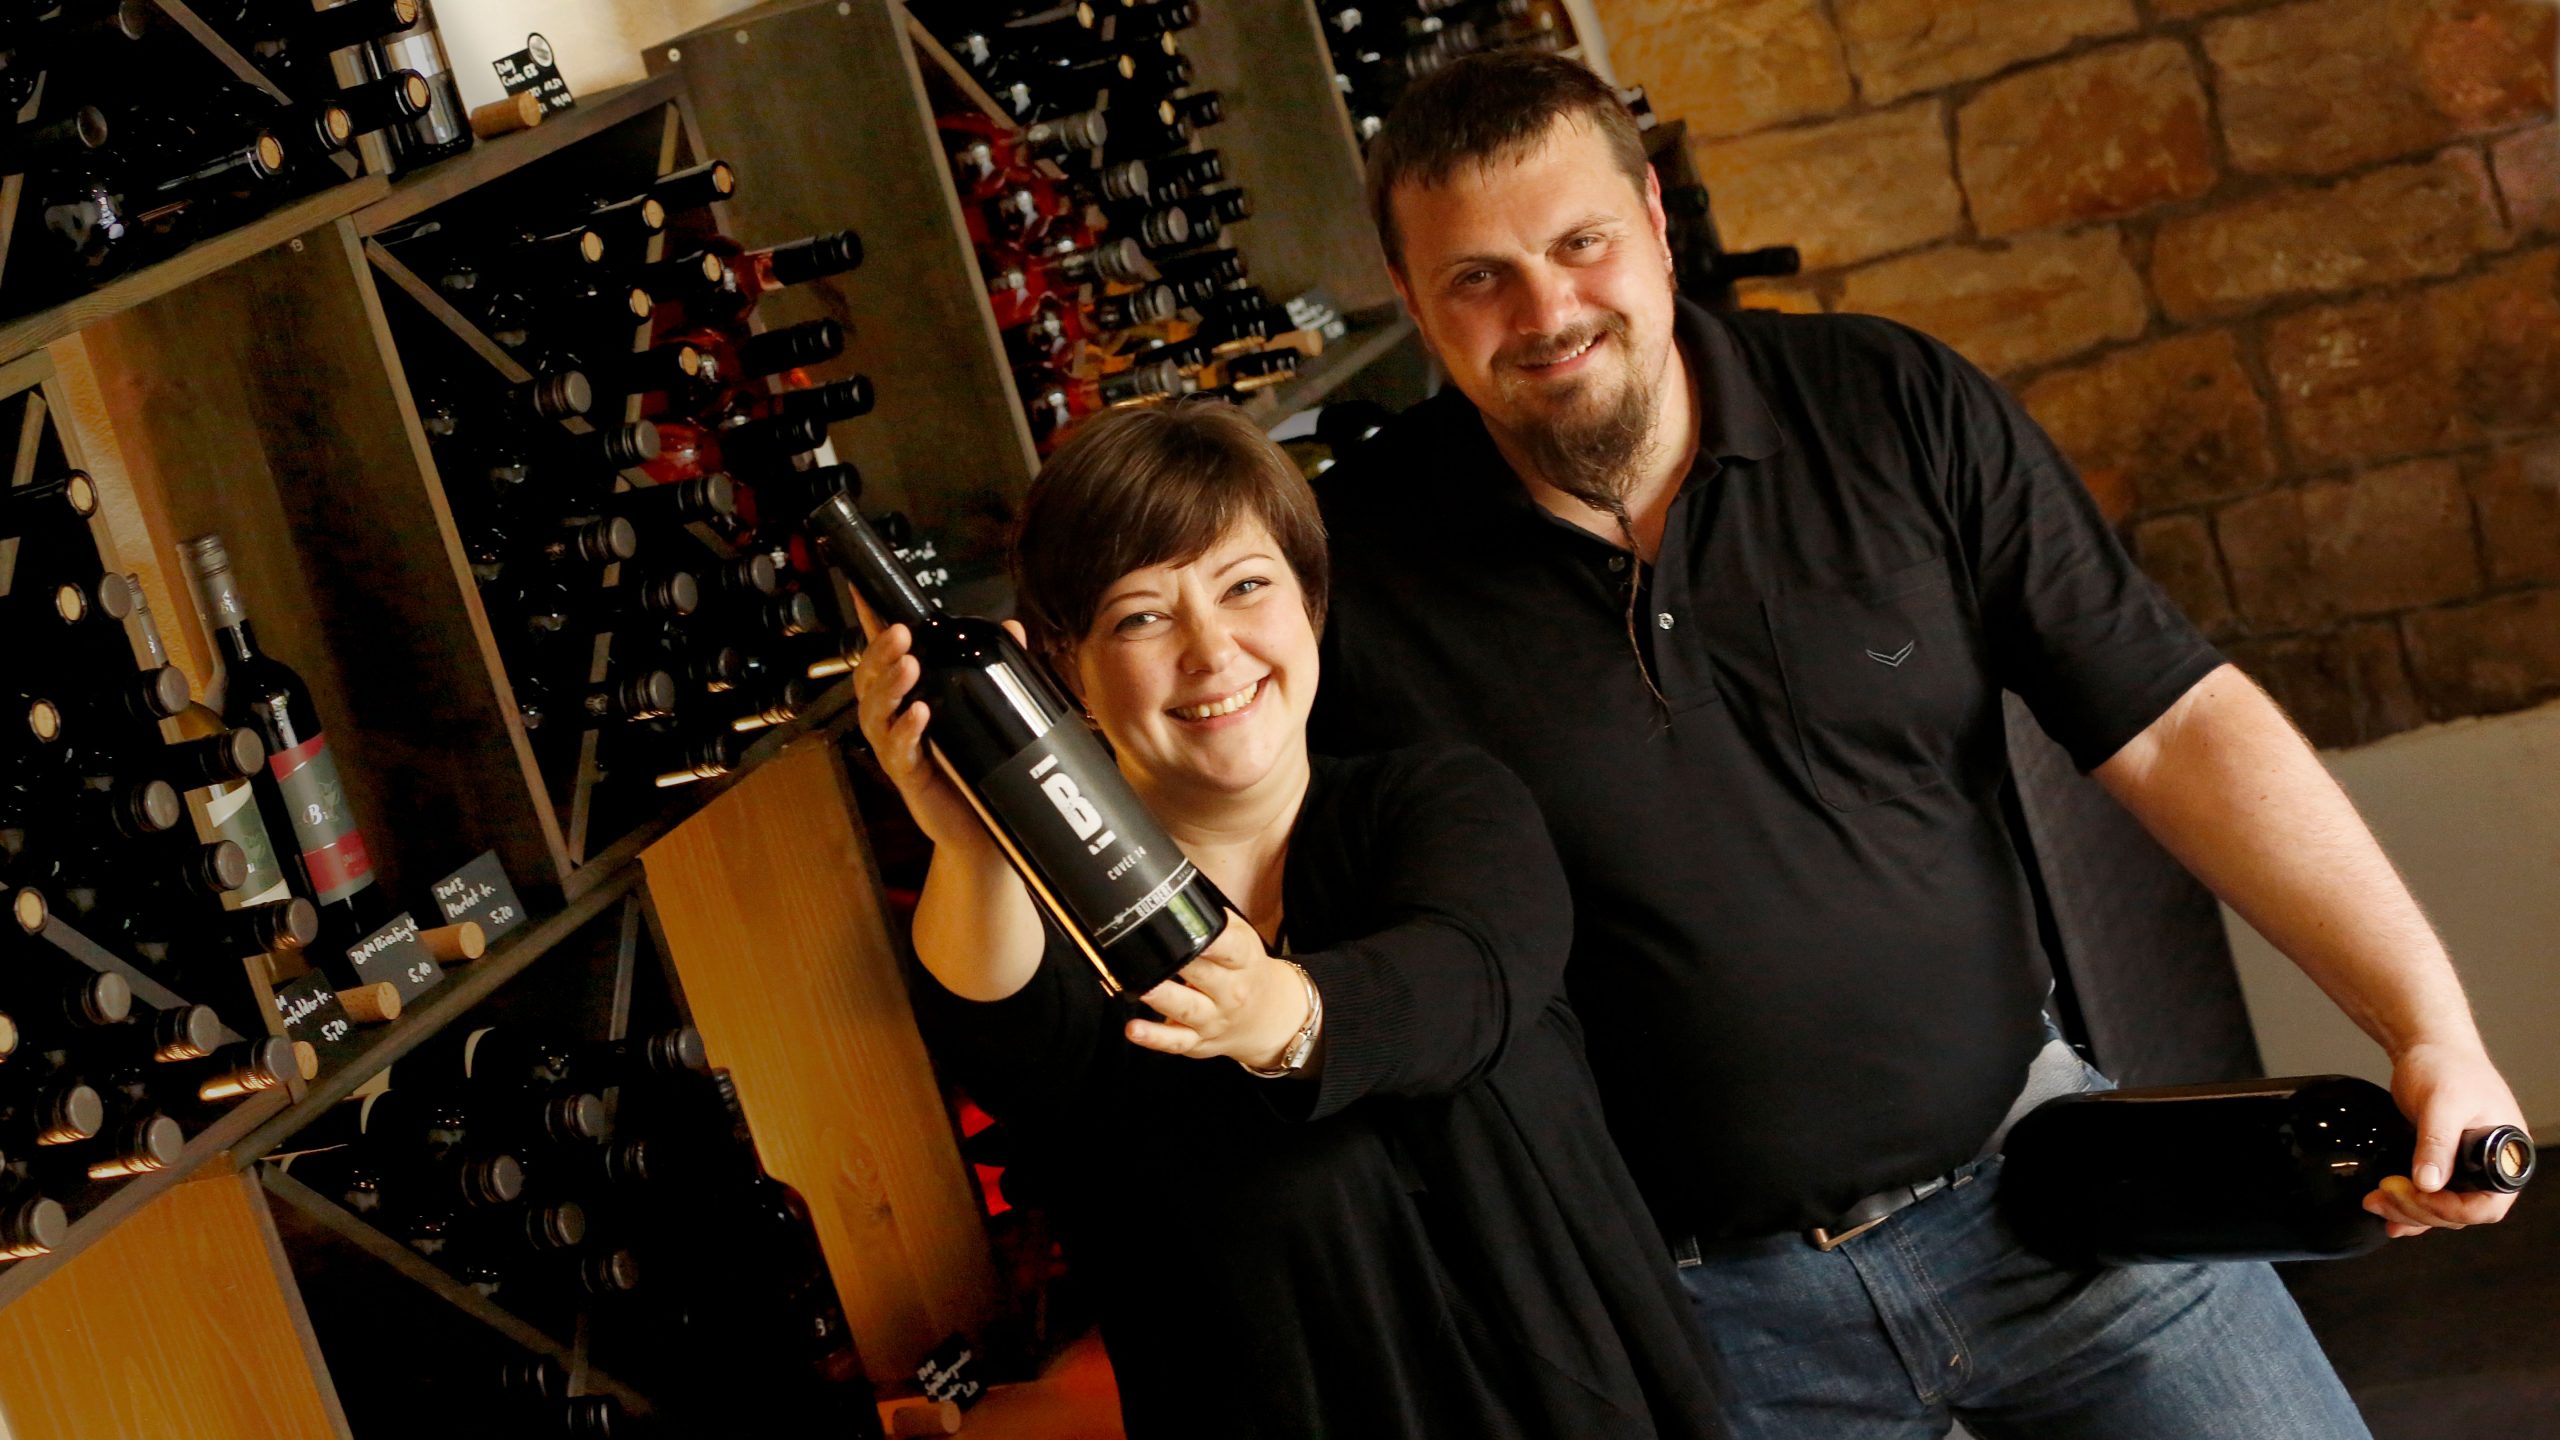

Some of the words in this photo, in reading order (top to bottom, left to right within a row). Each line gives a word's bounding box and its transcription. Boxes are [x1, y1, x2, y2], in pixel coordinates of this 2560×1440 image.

[1107, 854, 1137, 881] CUVÉE
[1134, 845, 1147, 858] 14
[437, 877, 465, 900] 2013
[446, 887, 480, 918] Merlot
[489, 905, 514, 924] 5,20
[407, 961, 432, 983] 5,10
[321, 1019, 348, 1042] 5,20
